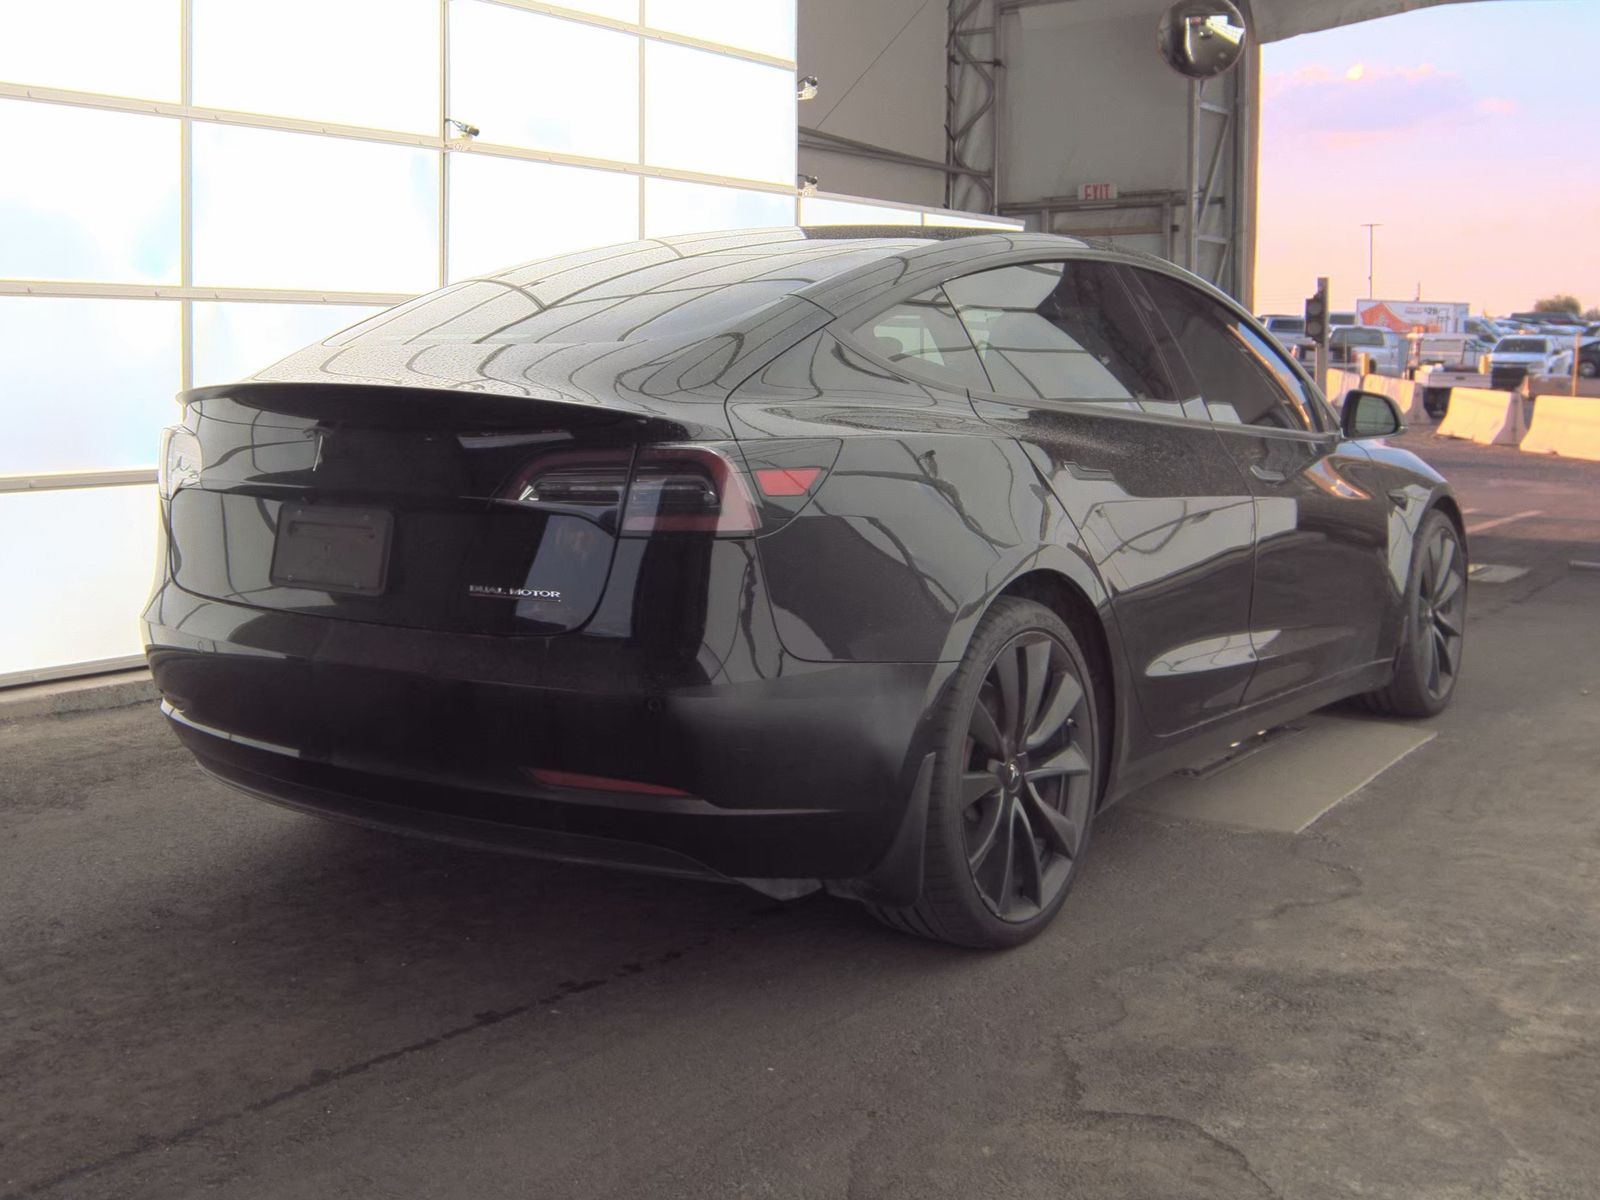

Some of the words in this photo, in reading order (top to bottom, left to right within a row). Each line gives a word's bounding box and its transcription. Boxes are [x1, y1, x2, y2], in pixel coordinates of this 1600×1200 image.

[1084, 183, 1111, 200] EXIT
[469, 585, 507, 595] DUAL
[509, 588, 561, 598] MOTOR
